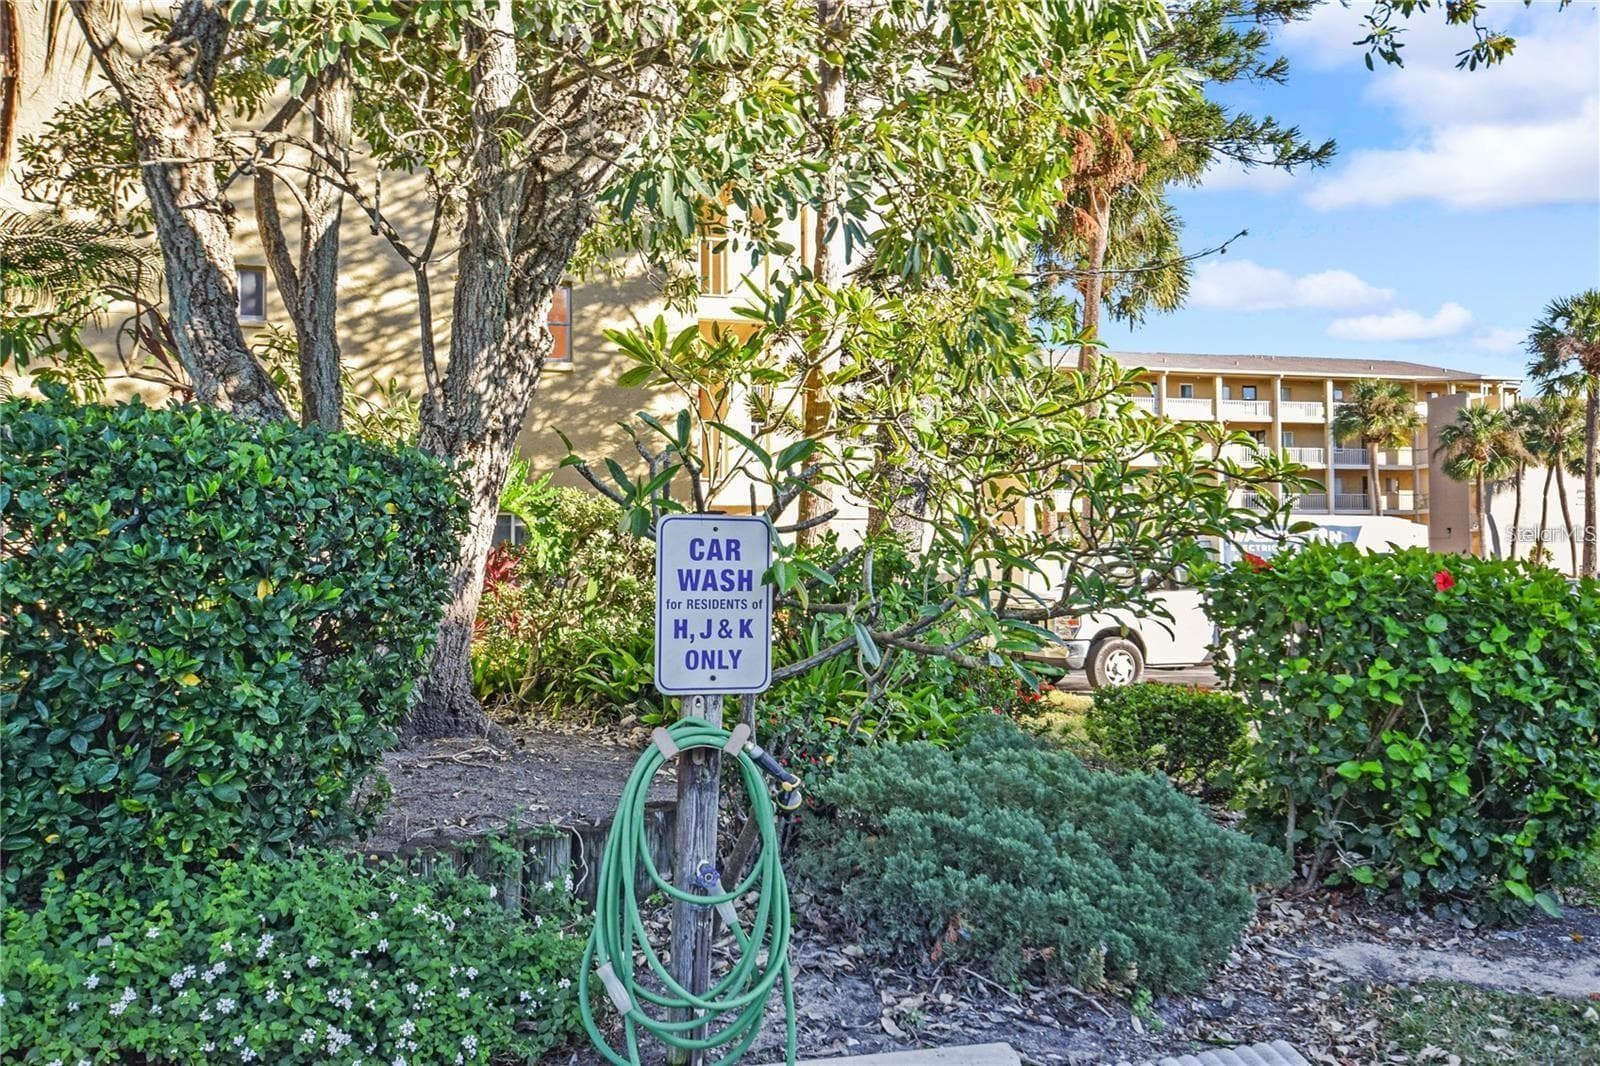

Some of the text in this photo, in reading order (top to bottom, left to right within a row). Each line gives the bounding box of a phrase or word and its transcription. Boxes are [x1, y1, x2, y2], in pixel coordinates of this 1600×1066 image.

[689, 538, 741, 561] CAR
[677, 569, 753, 592] WASH
[666, 599, 763, 610] for RESIDENTS of
[685, 649, 742, 670] ONLY
